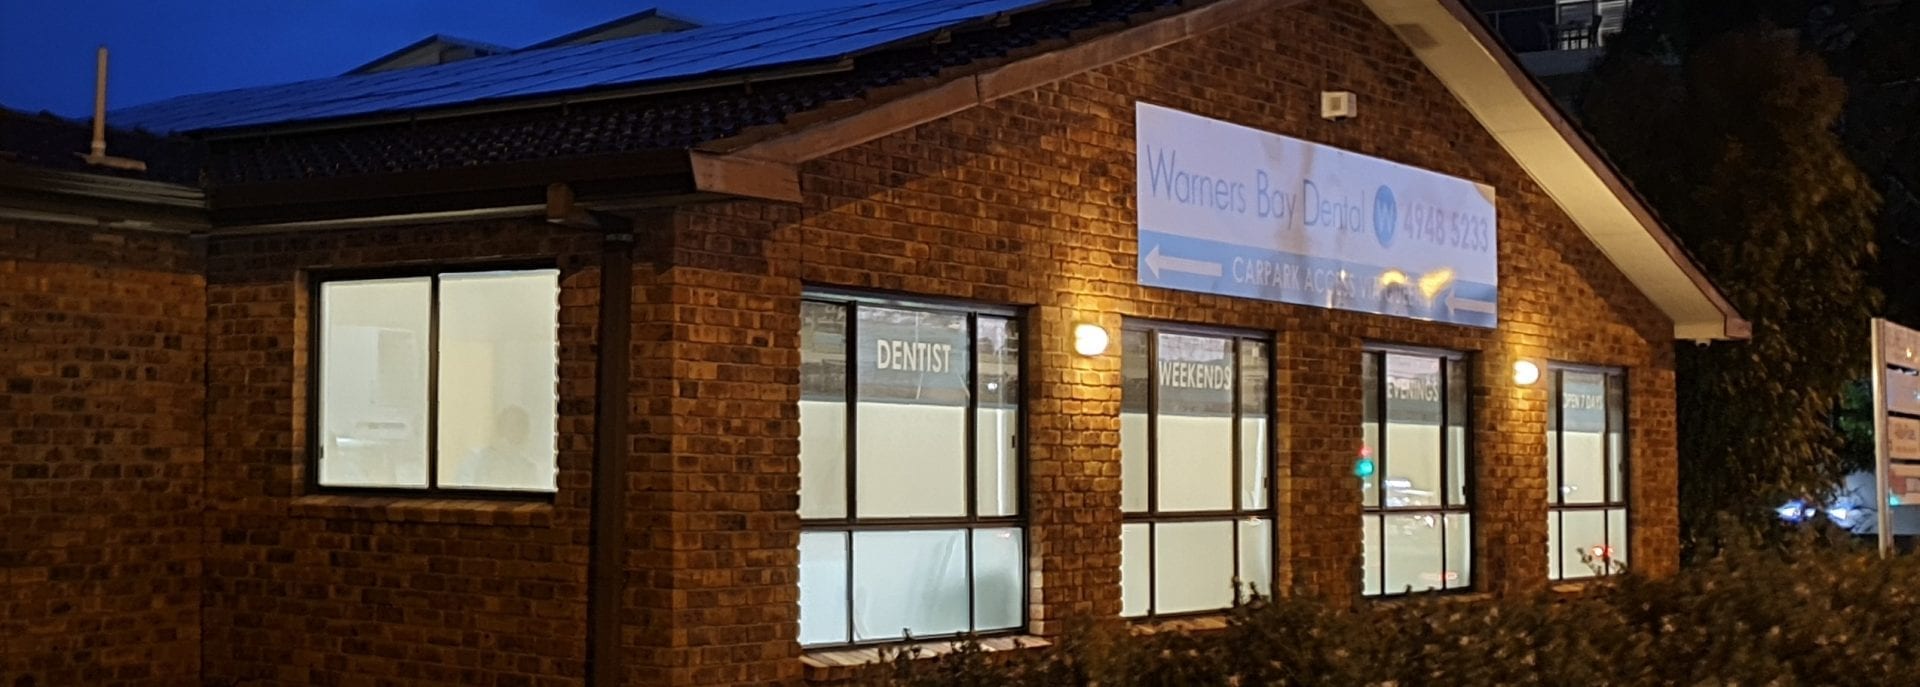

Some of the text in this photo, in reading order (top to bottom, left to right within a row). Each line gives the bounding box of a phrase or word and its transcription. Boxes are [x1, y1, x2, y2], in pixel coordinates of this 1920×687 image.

[1146, 143, 1246, 214] Warners
[1255, 168, 1296, 230] Bay
[1303, 178, 1365, 233] Dental
[1403, 201, 1445, 246] 4948
[1451, 211, 1489, 253] 5233
[1232, 256, 1300, 291] CARPARK
[877, 339, 951, 373] DENTIST
[1159, 360, 1232, 390] WEEKENDS
[1386, 380, 1440, 402] EVENINGS
